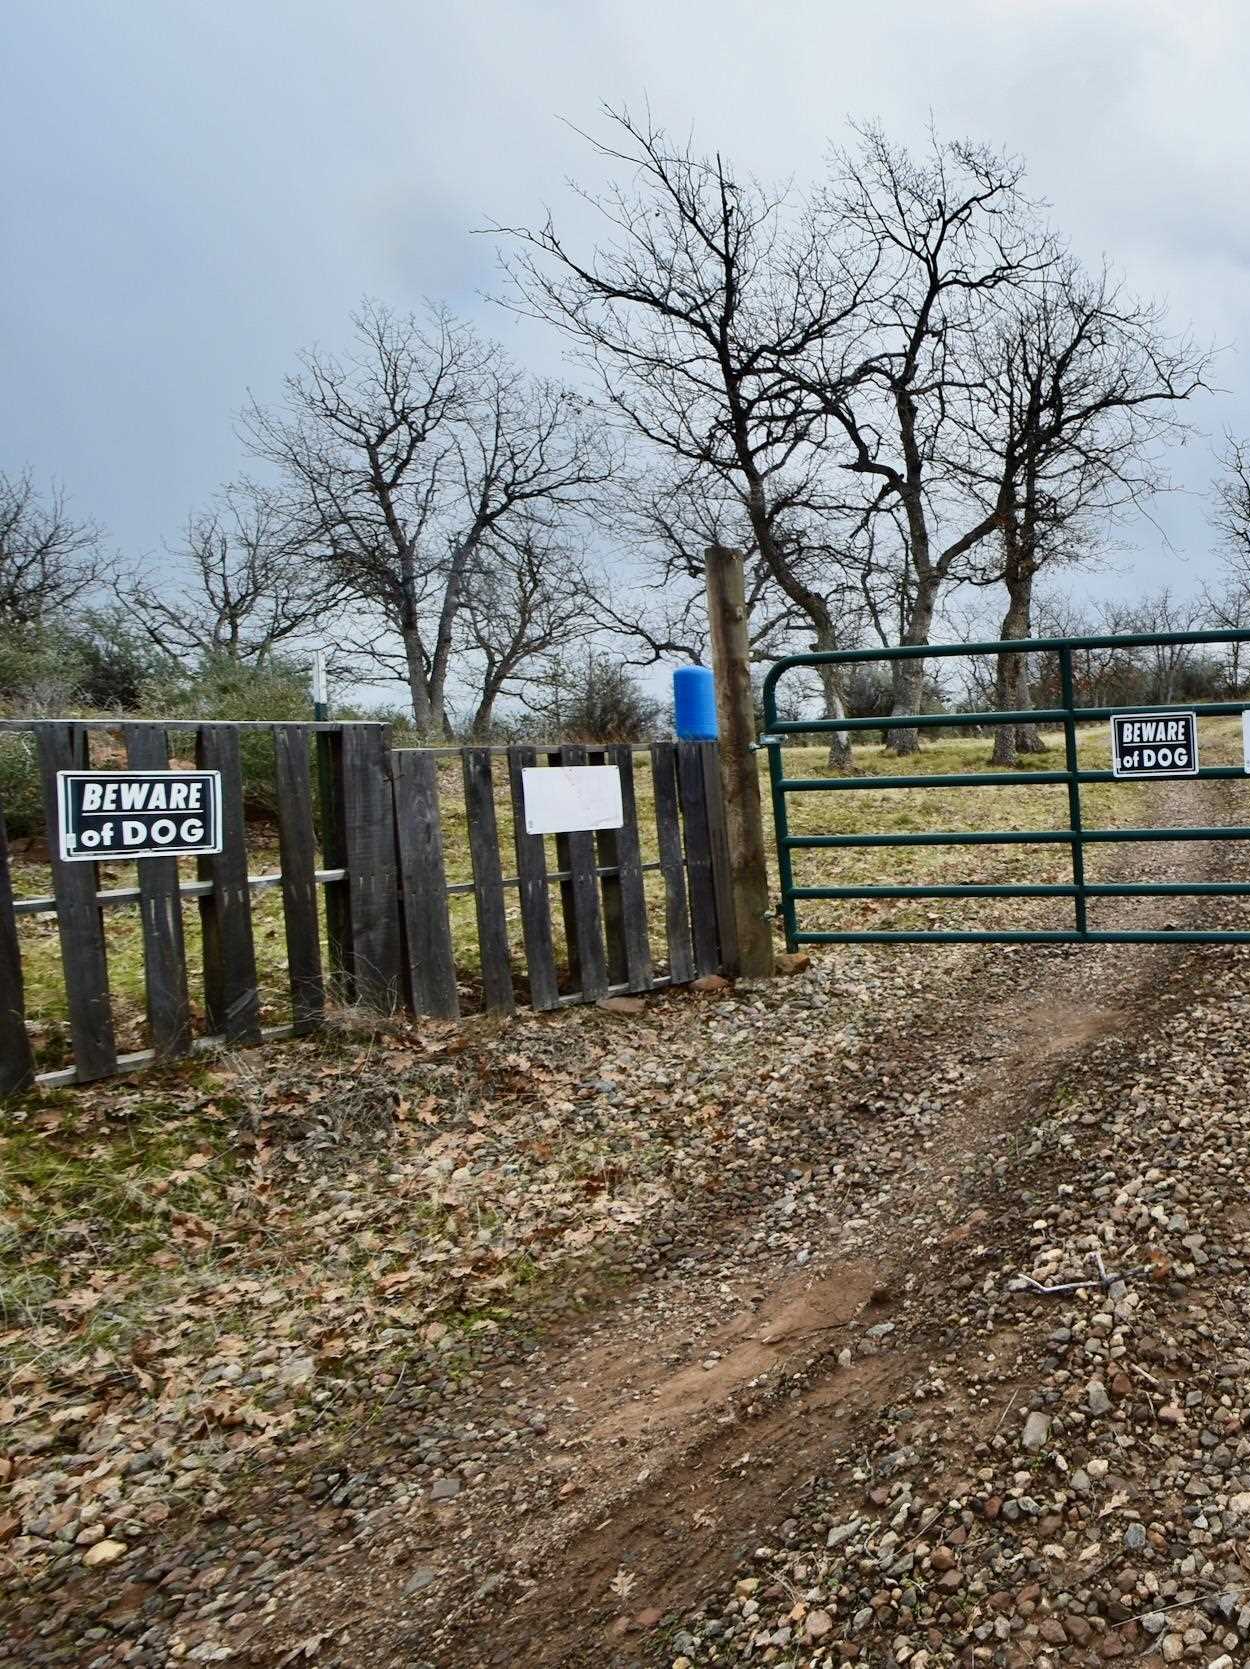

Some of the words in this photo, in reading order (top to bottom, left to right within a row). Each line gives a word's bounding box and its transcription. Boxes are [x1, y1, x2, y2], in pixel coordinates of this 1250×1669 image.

[1123, 721, 1186, 743] BEWARE
[1123, 751, 1140, 768] of
[1143, 748, 1188, 767] DOG
[82, 783, 202, 811] BEWARE
[81, 822, 114, 847] of
[122, 818, 204, 845] DOG
